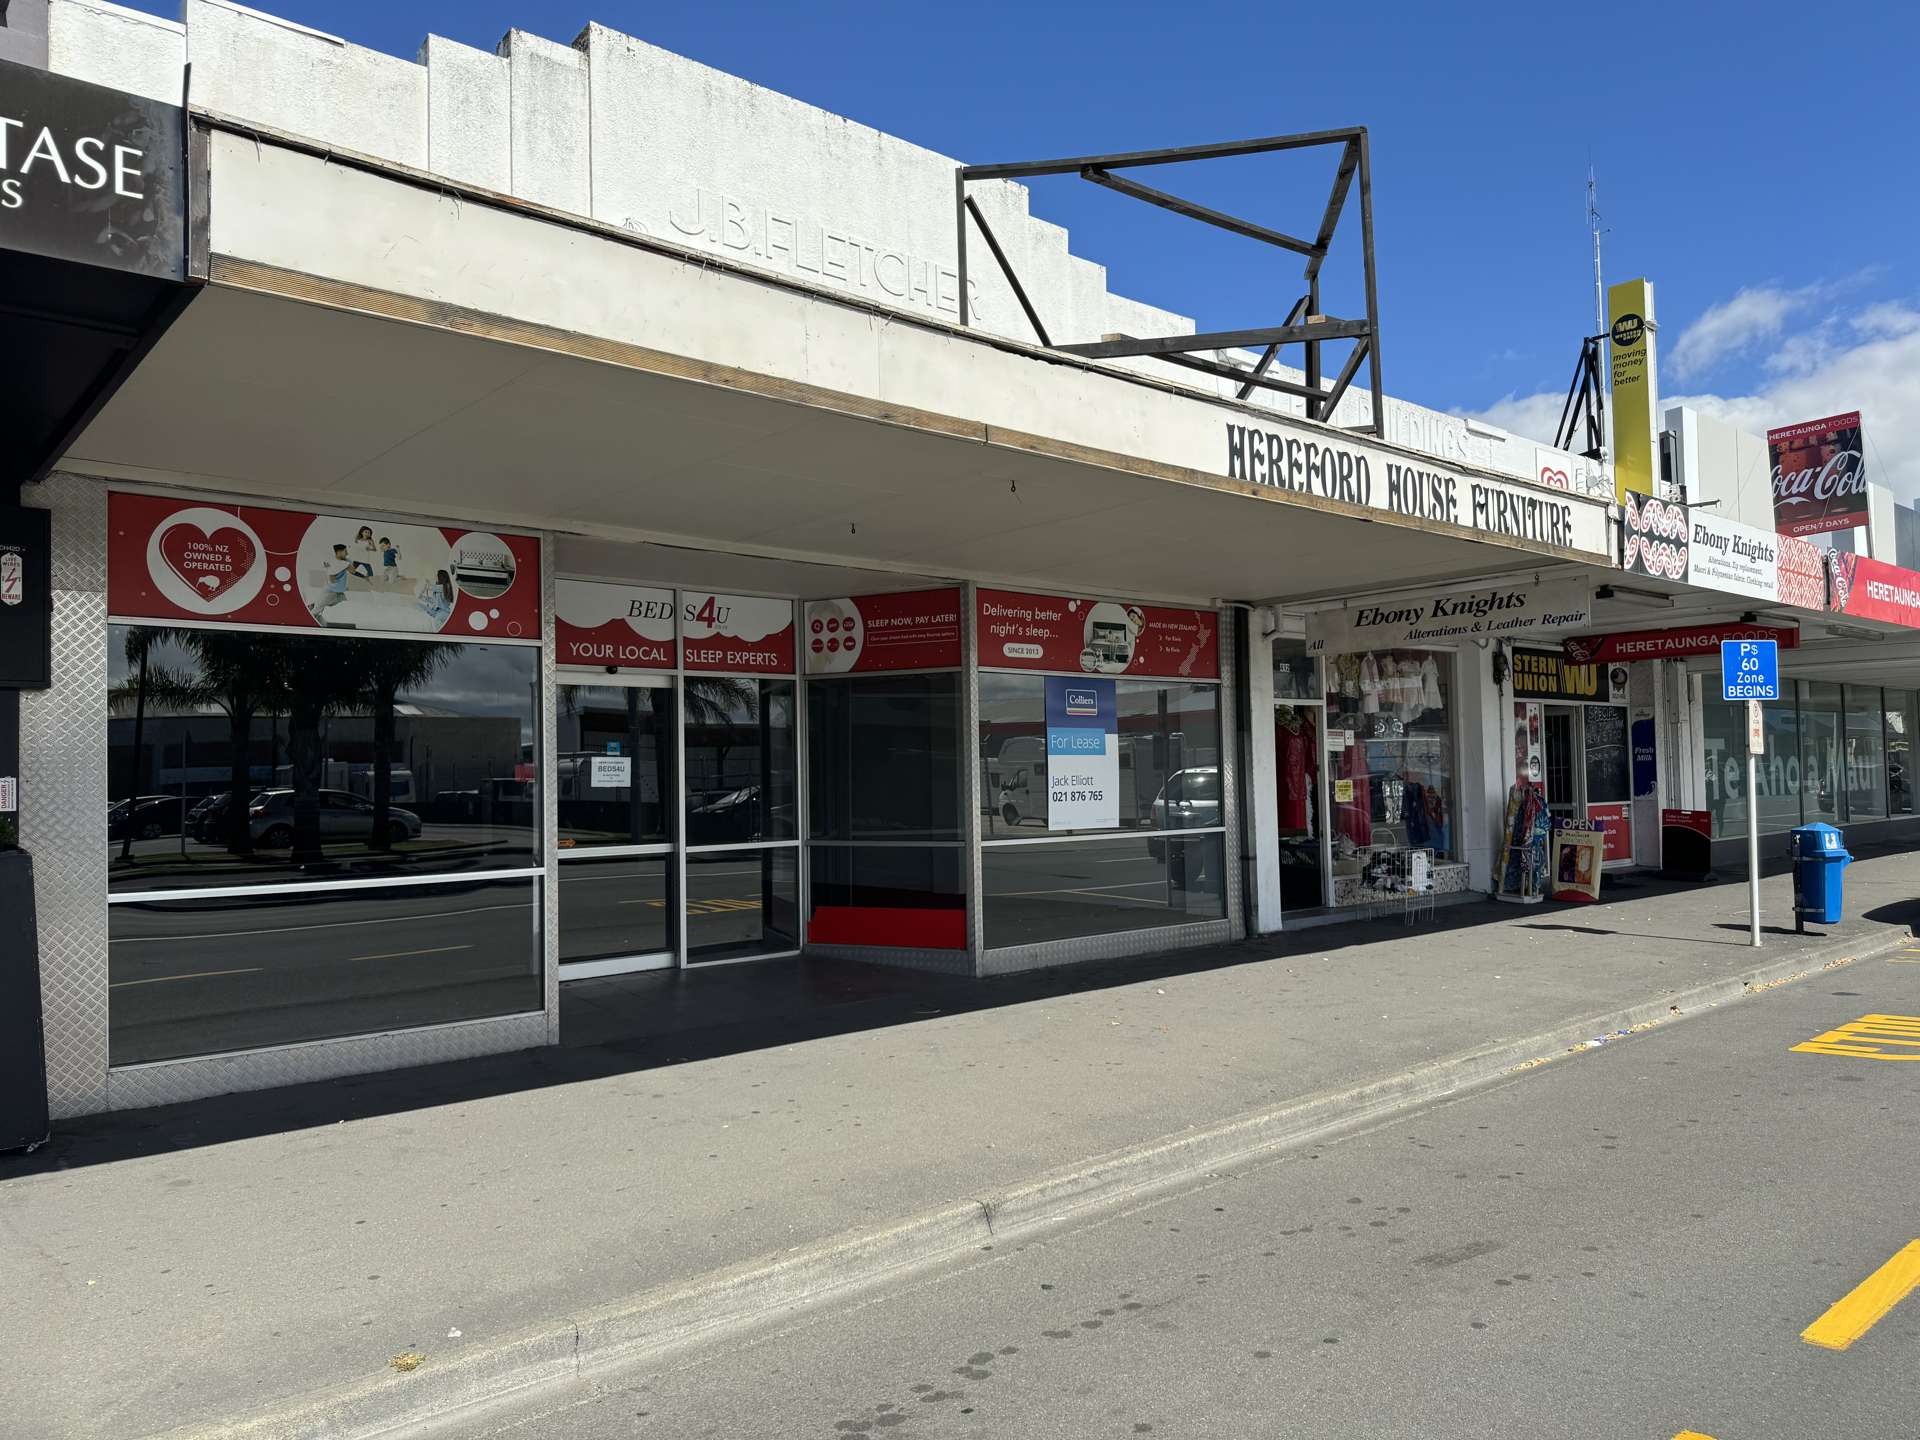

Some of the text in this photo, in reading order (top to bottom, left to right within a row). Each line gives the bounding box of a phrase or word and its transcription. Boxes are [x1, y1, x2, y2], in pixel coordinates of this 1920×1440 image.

[1613, 349, 1647, 361] moving
[1613, 358, 1644, 370] money
[1613, 370, 1626, 378] for
[1614, 375, 1640, 386] better
[1769, 416, 1858, 440] HERETAUNGA FOODS
[1226, 422, 1573, 547] HEREFORD HOUSE FURNITURE
[1793, 522, 1816, 533] OPEN
[1826, 518, 1850, 528] DAYS
[187, 542, 230, 553] 100% NZ
[1693, 523, 1775, 564] Ebony Knights
[183, 551, 232, 562] OWNED &
[183, 561, 233, 572] OPERATED
[1866, 579, 1920, 609] HERETAUNGA
[983, 602, 1062, 622] Delivering better
[1354, 591, 1526, 628] Ebony Knights
[868, 614, 957, 628] SLEEP NOW, PAY LATER!
[990, 622, 1024, 638] night's
[1308, 610, 1586, 651] All Alterations & Leather Repair
[1007, 646, 1024, 654] SINCE
[1616, 634, 1721, 654] HERETAUNGA
[570, 642, 778, 666] YOUR LOCAL SLEEP EXPERTS
[1741, 658, 1759, 671] 60
[1514, 672, 1558, 693] UNION
[1737, 672, 1764, 684] Zone
[1728, 685, 1774, 697] BEGINS
[1050, 734, 1100, 750] For Lease
[1703, 738, 1740, 800] Te
[1051, 775, 1094, 788] Jack Elliott
[1052, 790, 1103, 802] 021 876 765
[1562, 818, 1595, 831] OPEN
